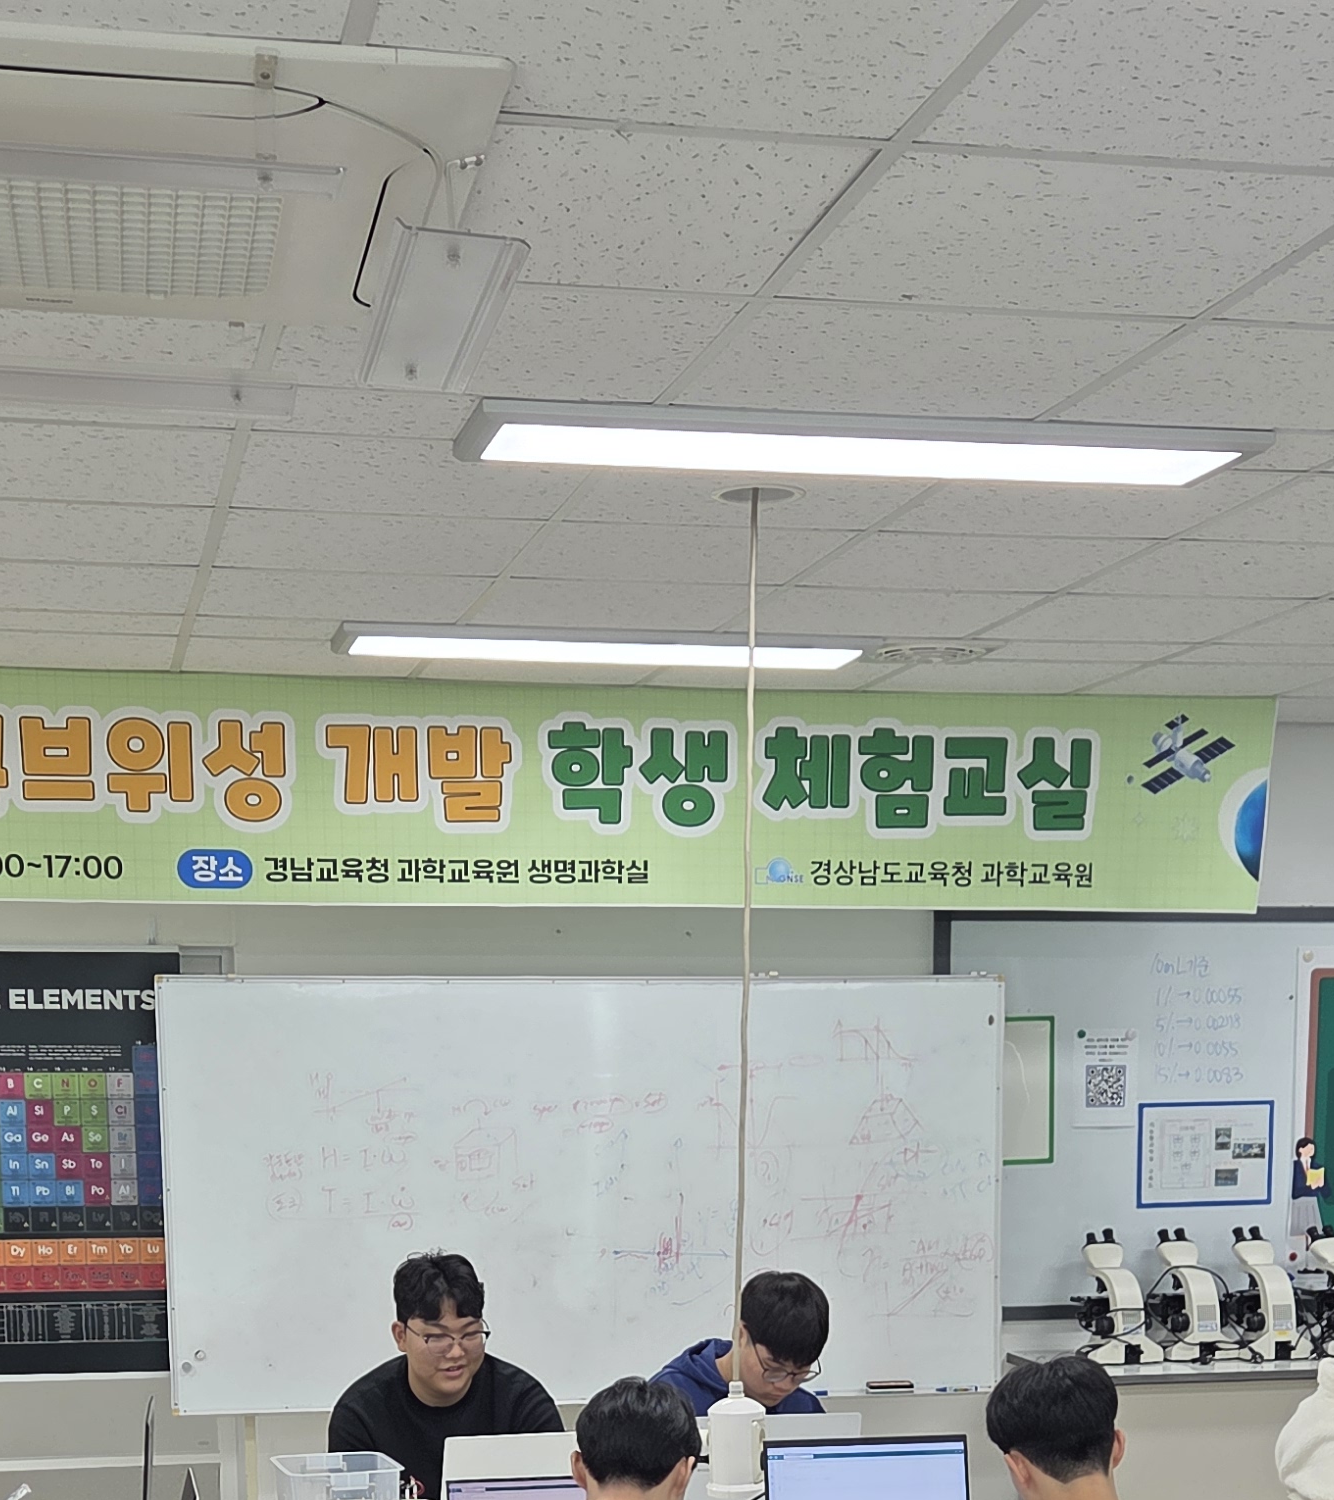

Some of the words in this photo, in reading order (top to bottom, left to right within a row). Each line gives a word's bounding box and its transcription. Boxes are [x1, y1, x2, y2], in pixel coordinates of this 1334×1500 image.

[326, 723, 512, 823] 개발
[548, 721, 728, 827] 학생
[763, 726, 1093, 831] 체험교실
[191, 855, 244, 883] 장소
[264, 857, 389, 883] 경남교육청
[397, 858, 519, 884] 과학교육원
[528, 858, 649, 884] 생명과학실
[810, 859, 972, 887] 경상남도교육청
[981, 860, 1093, 889] 과학교육원
[8, 988, 155, 1011] ELEMENTS
[7, 1078, 14, 1088] B
[34, 1078, 42, 1088] C
[64, 1106, 70, 1115] P
[91, 1105, 98, 1115] S
[4, 1132, 21, 1142] Ga
[61, 1132, 74, 1142] As
[9, 1159, 19, 1169] In
[35, 1159, 48, 1169] Sn
[62, 1159, 76, 1169] Sb
[36, 1186, 50, 1195] Pb
[91, 1185, 104, 1195] Po
[11, 1245, 26, 1258] Dy
[38, 1245, 53, 1255] Ho
[92, 1244, 107, 1254] Tm
[119, 1244, 133, 1253] Yb
[147, 1243, 159, 1253] Lu
